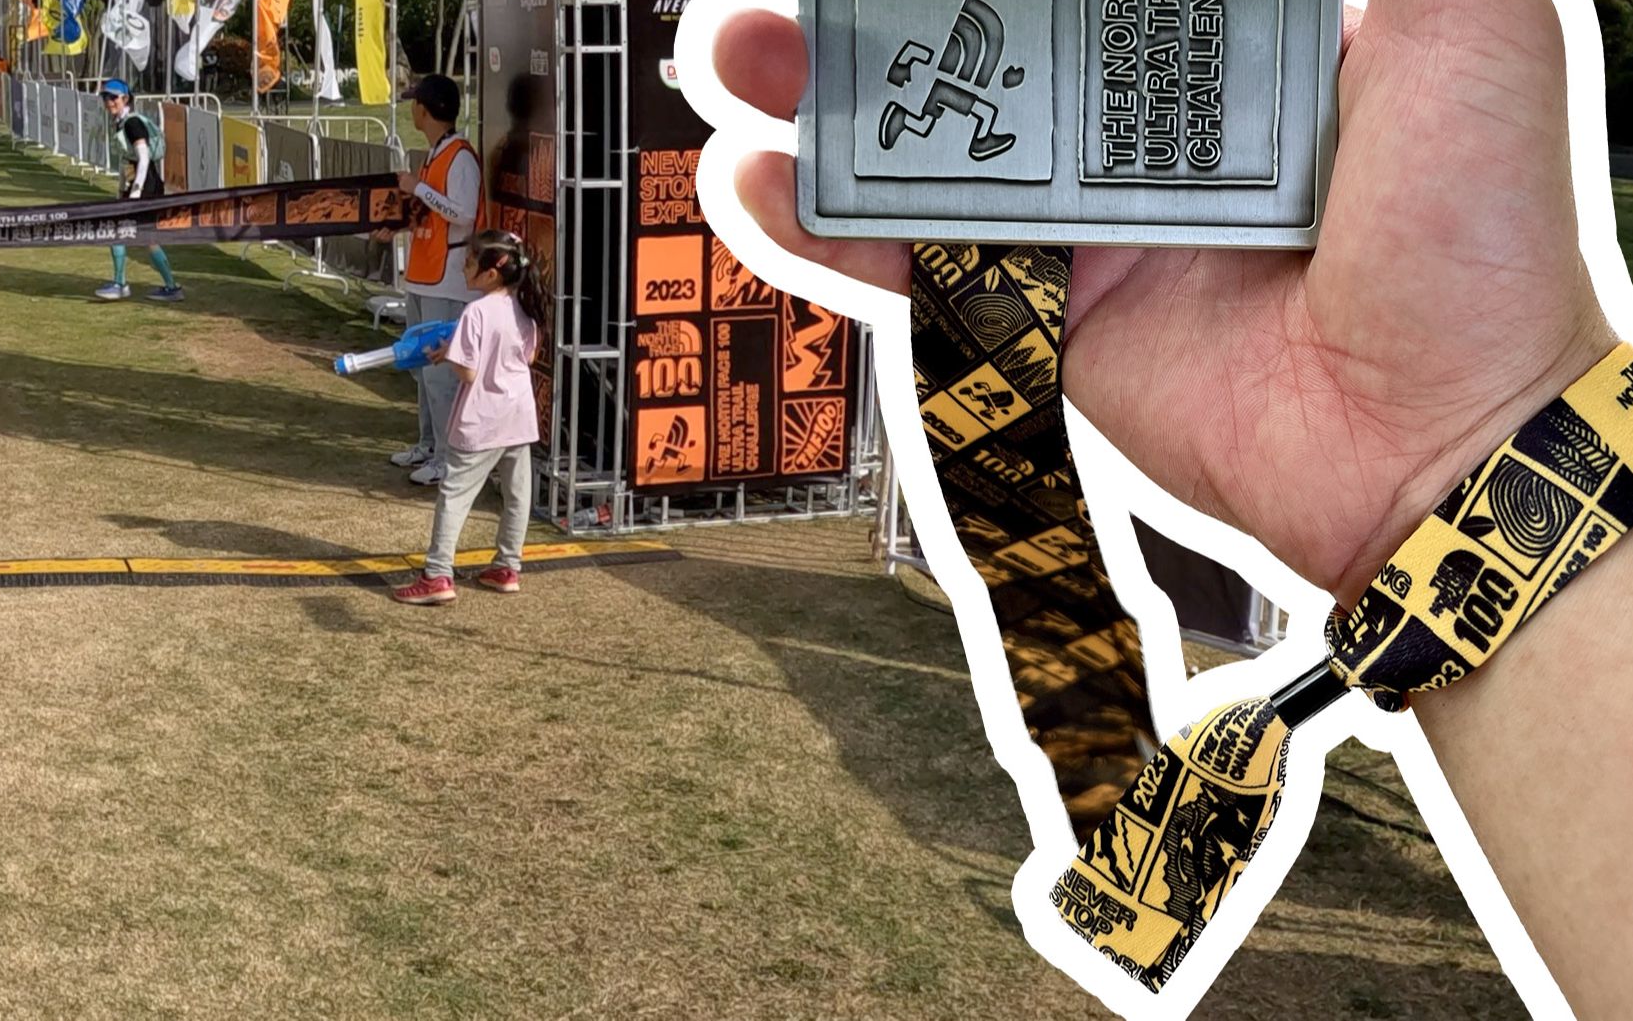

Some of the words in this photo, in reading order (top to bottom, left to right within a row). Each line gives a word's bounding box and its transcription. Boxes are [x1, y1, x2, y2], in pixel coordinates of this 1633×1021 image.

[1144, 40, 1181, 169] ULTRA
[1103, 89, 1140, 170] THE
[640, 150, 700, 175] NEVE
[18, 213, 46, 222] FACE
[49, 212, 68, 221] 100
[645, 280, 696, 301] 2023
[638, 331, 679, 347] NORTH
[656, 321, 680, 334] THE
[636, 357, 702, 398] 100
[718, 350, 730, 388] FACE
[718, 390, 730, 443] NORTH
[718, 445, 730, 474] THE
[1583, 523, 1608, 553] 100
[1454, 568, 1519, 654] 100
[1133, 746, 1168, 812] 2023
[1049, 883, 1113, 935] STOP
[1061, 867, 1138, 932] NEVER
